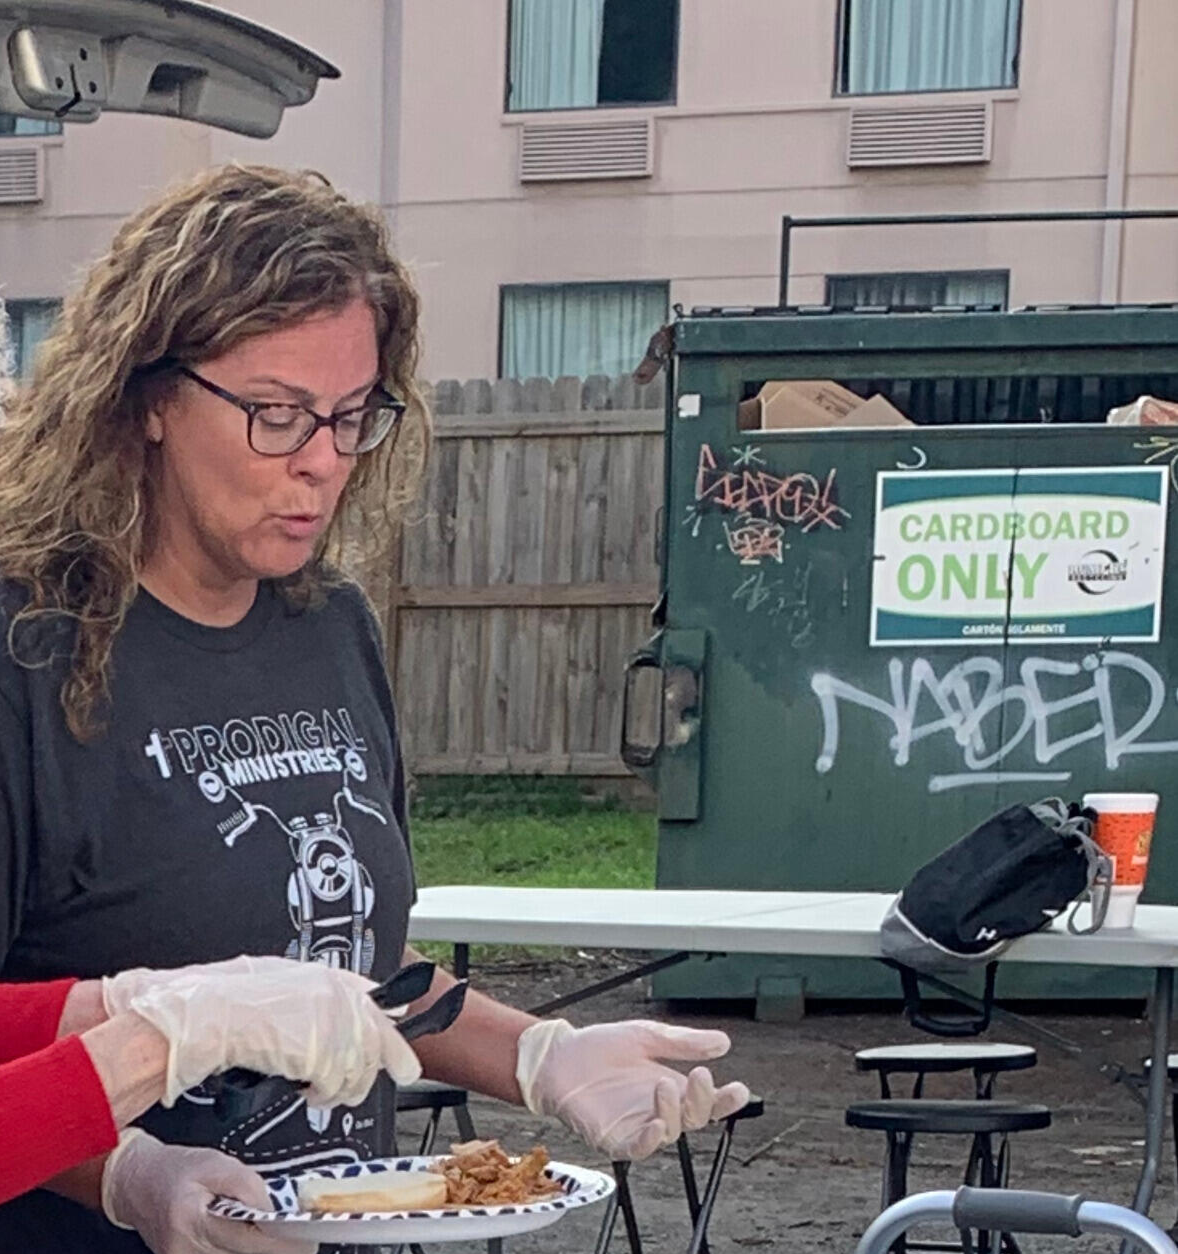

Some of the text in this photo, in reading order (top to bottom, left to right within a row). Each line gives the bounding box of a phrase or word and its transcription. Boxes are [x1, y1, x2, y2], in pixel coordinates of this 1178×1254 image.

[899, 510, 1130, 543] CARDBOARD
[897, 552, 1048, 601] ONLY
[170, 707, 367, 774] PRODIGAL
[222, 747, 343, 787] MINISTRIES
